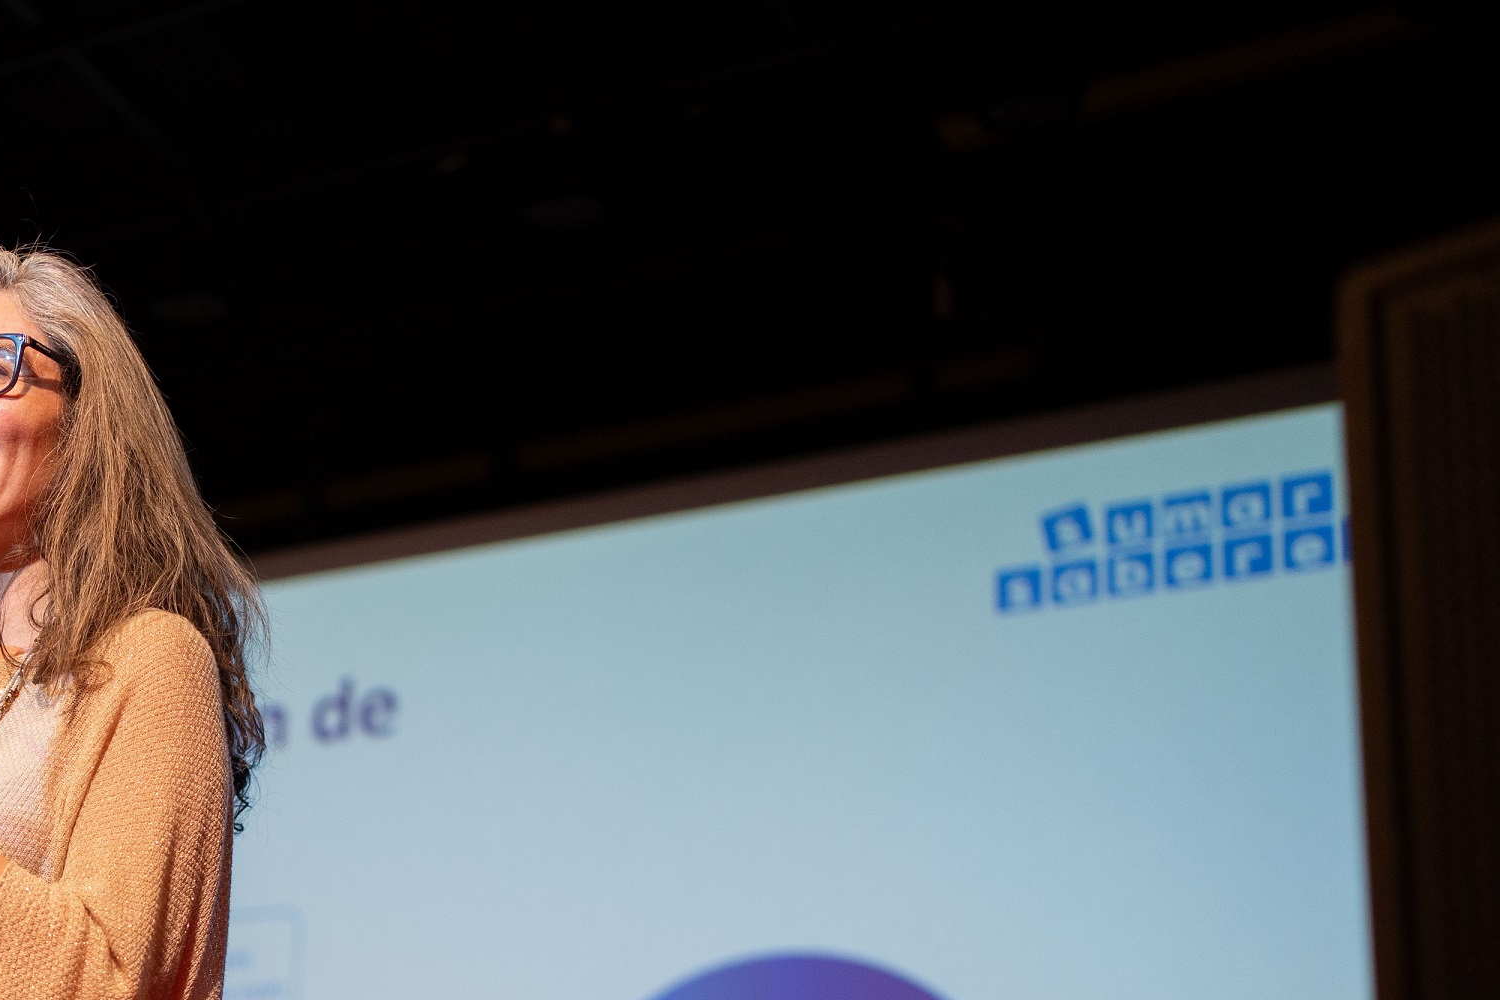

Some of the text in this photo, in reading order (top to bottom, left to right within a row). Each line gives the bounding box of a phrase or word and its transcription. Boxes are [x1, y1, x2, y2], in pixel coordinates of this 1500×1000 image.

[1043, 474, 1332, 550] sumar
[998, 527, 1348, 612] sabere
[311, 675, 399, 744] de
